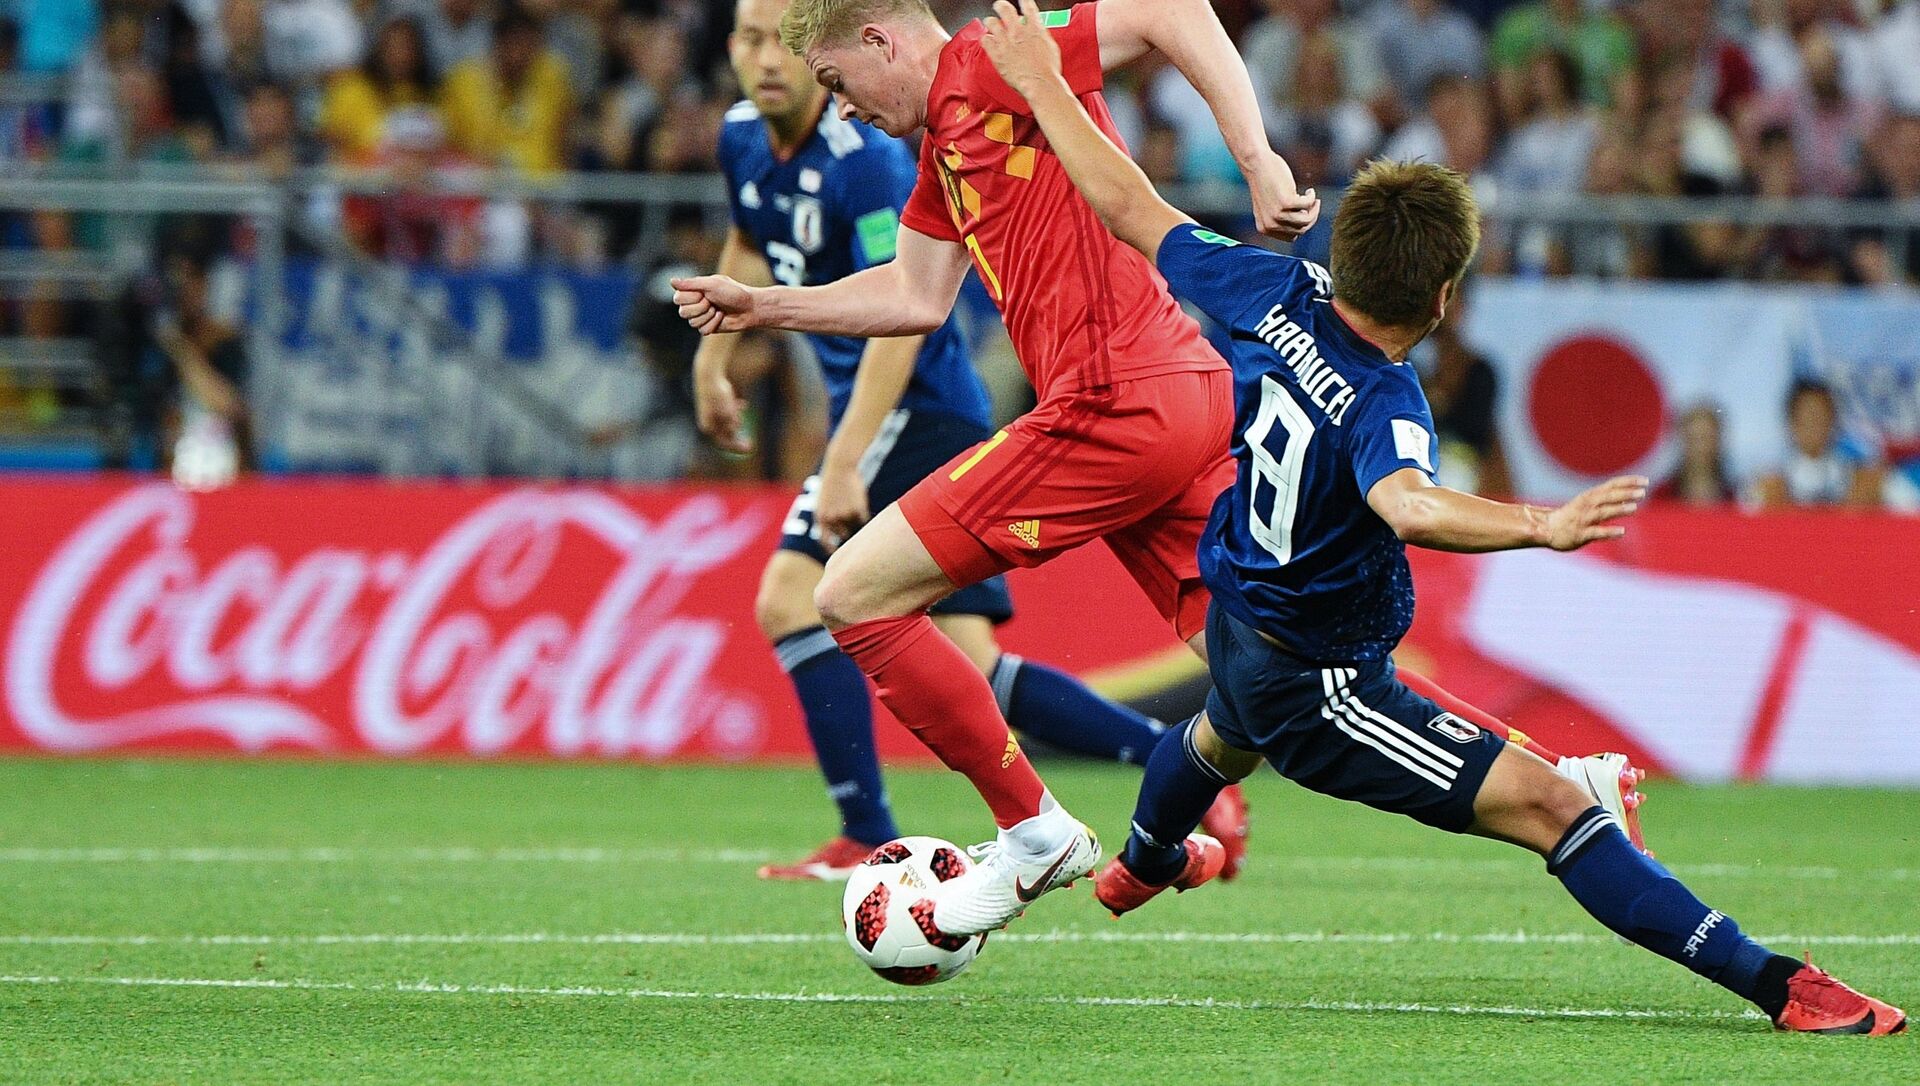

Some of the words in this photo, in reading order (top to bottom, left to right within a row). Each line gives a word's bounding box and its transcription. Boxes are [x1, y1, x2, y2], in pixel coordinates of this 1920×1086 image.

[1008, 523, 1040, 549] adidas
[1244, 374, 1316, 566] 8
[4, 483, 771, 755] Coca-Cola
